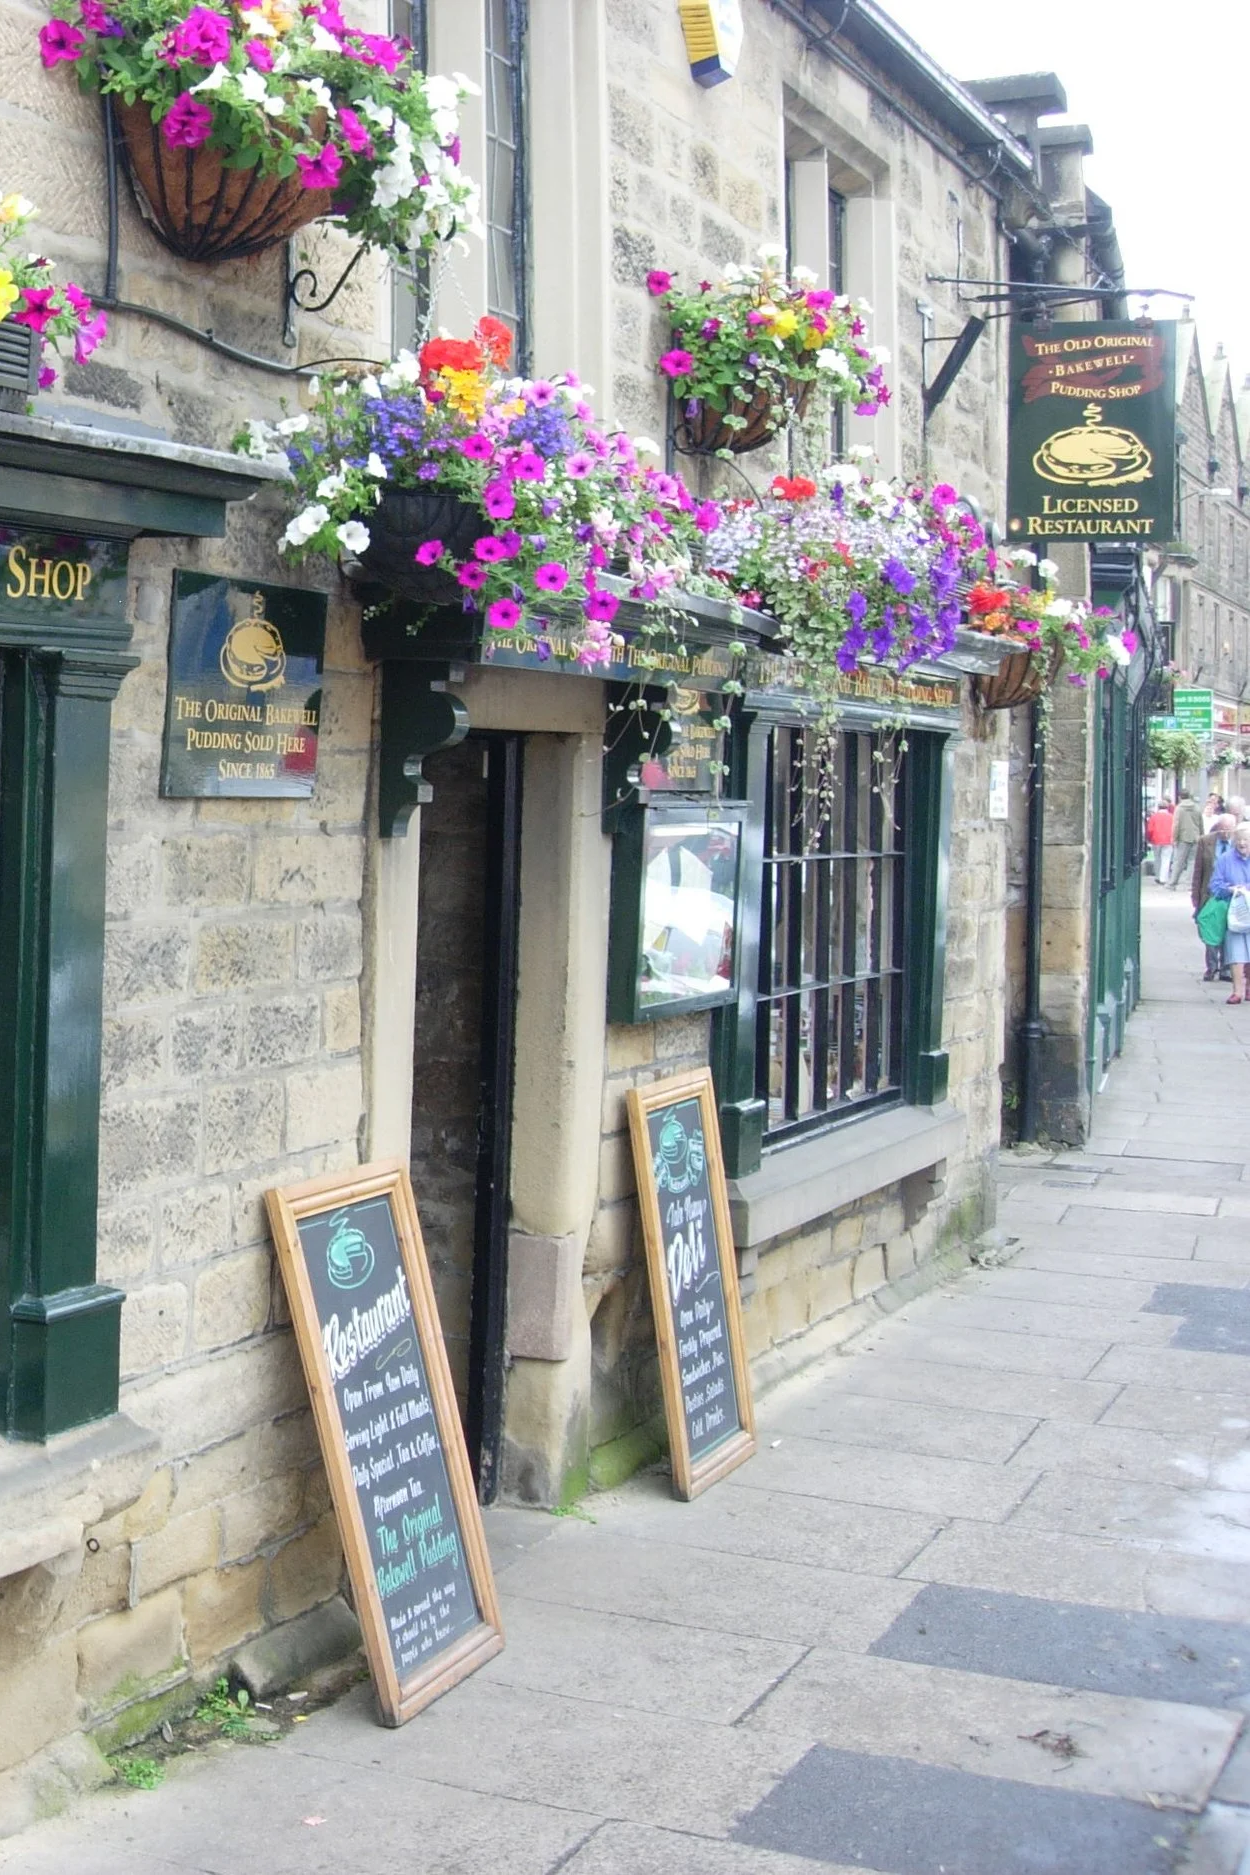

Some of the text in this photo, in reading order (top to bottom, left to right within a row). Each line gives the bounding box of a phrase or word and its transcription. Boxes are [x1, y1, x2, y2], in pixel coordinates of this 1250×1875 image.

[1035, 336, 1155, 356] THE OLD ORIGINAL
[1051, 381, 1142, 399] PUDDING SHOP
[1042, 495, 1139, 514] LICENSED
[1027, 517, 1154, 536] RESTAURANT
[6, 546, 93, 600] SHOP
[175, 696, 318, 726] THE ORIGINAL BAKEWELL
[186, 728, 306, 756] PUDDING SOLD HERE
[218, 759, 275, 782] SINCE 1865
[323, 1265, 411, 1384] Restaurant
[343, 1387, 364, 1413] Open
[402, 1492, 443, 1544] Original
